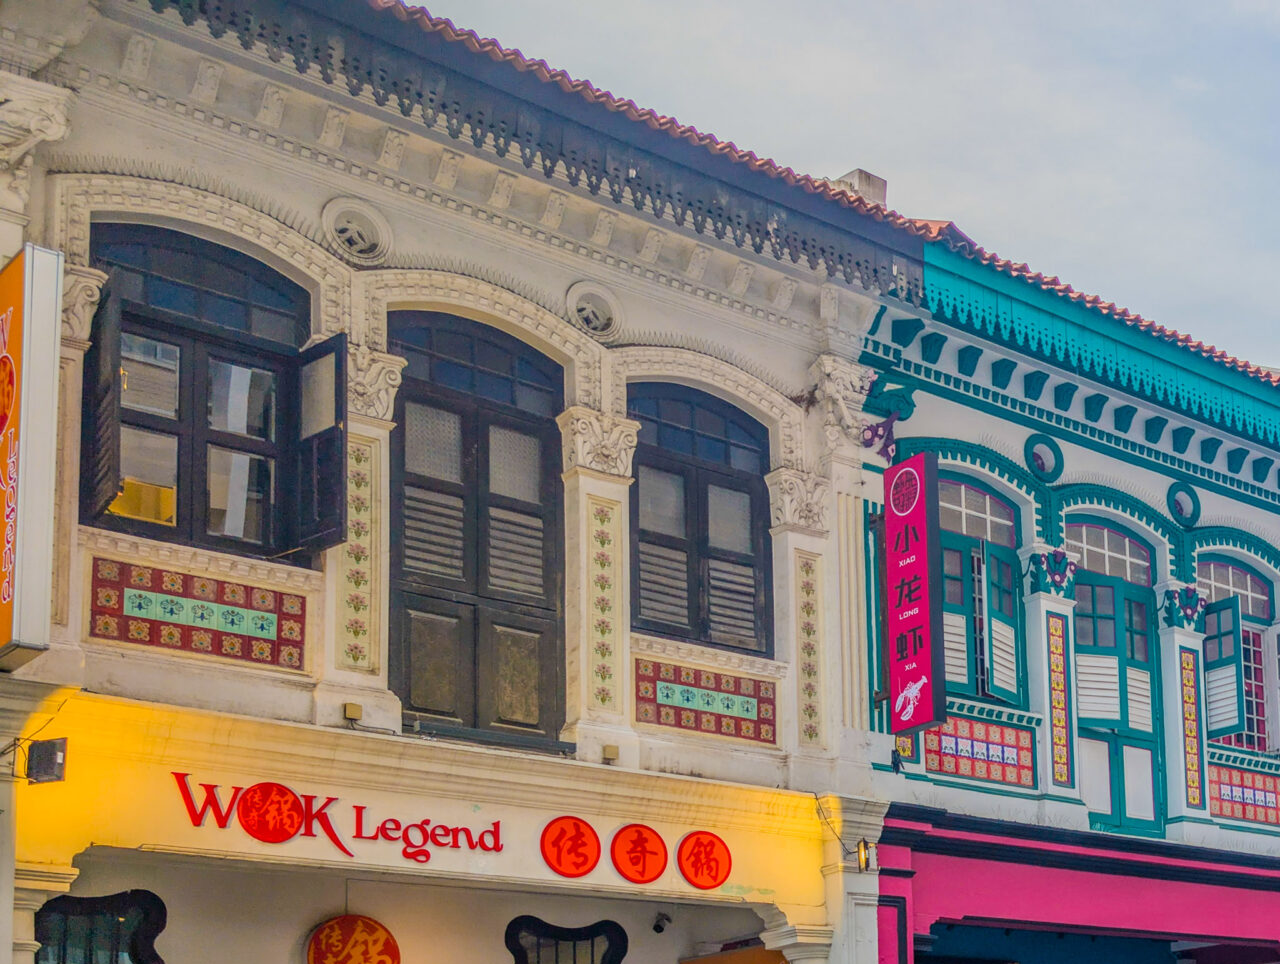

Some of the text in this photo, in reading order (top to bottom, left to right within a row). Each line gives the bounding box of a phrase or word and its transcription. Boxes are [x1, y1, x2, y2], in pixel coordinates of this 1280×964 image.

[899, 555, 916, 568] XIAO
[899, 607, 919, 620] LONG
[904, 661, 917, 672] XIA
[171, 772, 504, 863] WOK Legend
